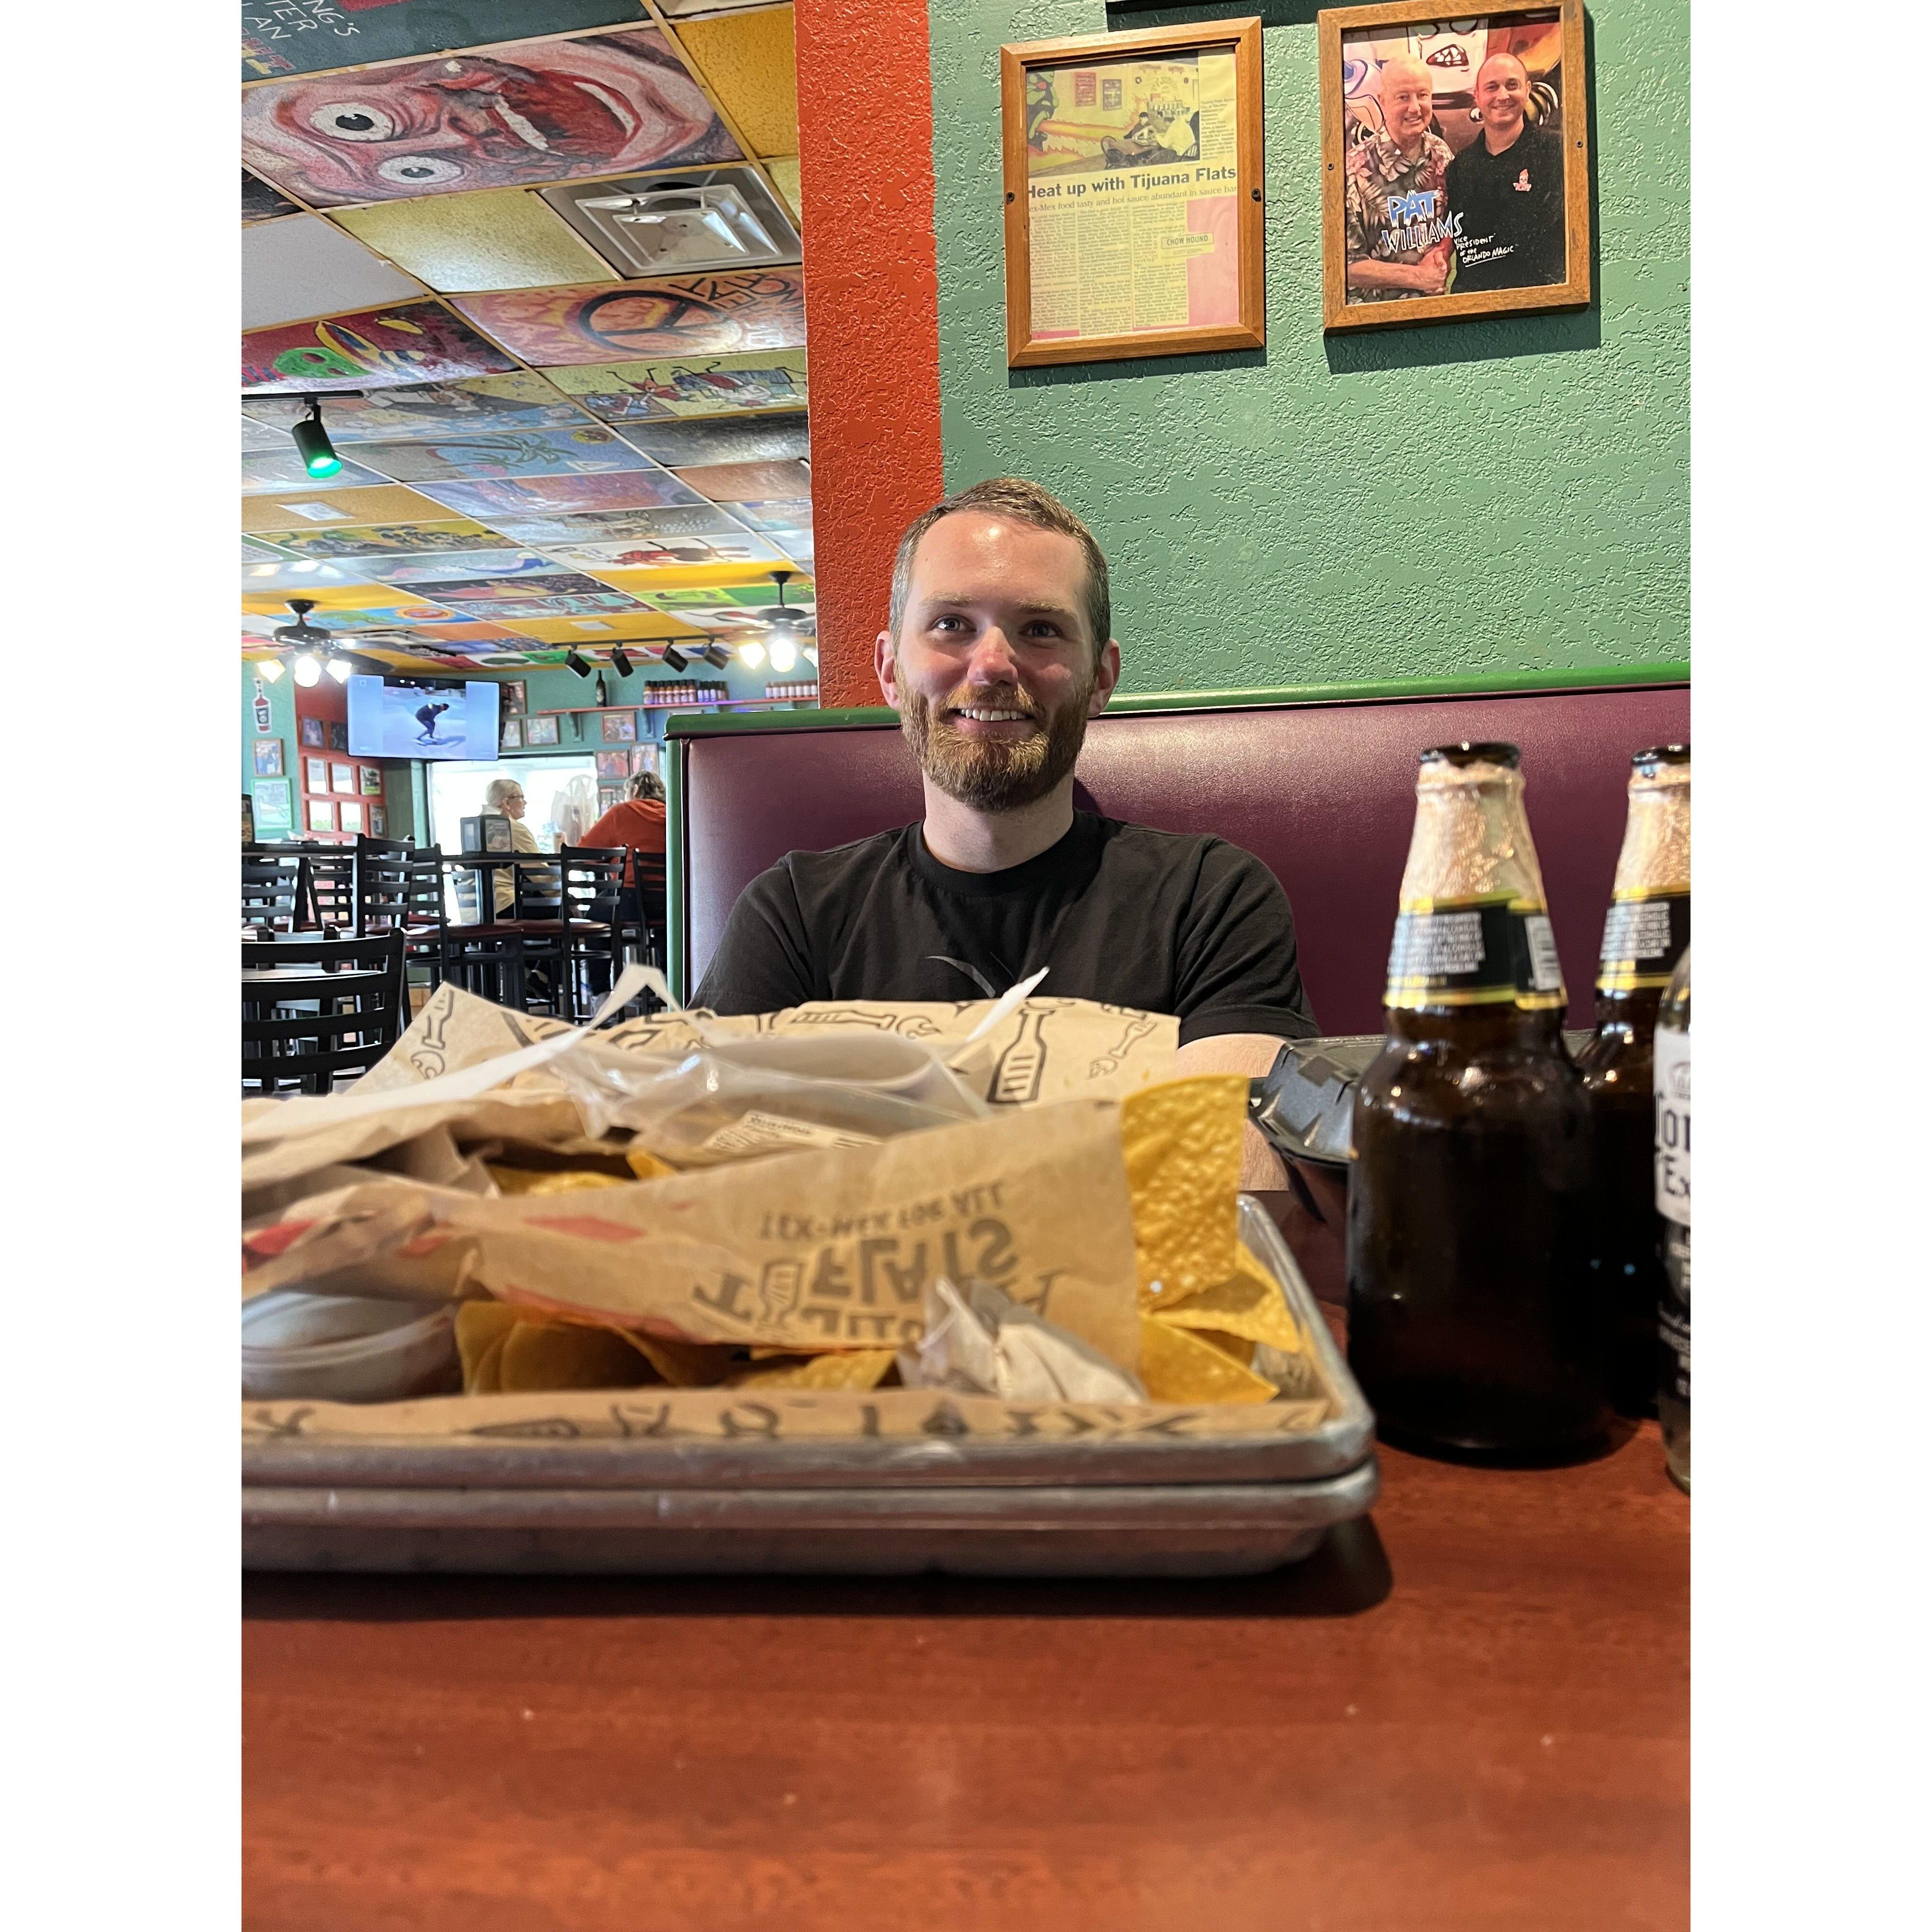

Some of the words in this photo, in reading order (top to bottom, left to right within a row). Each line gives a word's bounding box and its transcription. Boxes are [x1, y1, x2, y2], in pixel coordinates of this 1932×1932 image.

[1028, 183, 1061, 198] Heat
[1067, 184, 1087, 197] up
[1092, 176, 1125, 192] with
[1130, 173, 1190, 190] Tijuana
[1196, 166, 1237, 182] Flats
[1029, 203, 1056, 212] ex-Mex
[1058, 201, 1075, 210] food
[1077, 200, 1094, 209] tasty
[1096, 197, 1110, 206] and
[1151, 191, 1187, 201] abundant
[1189, 189, 1197, 197] in
[1199, 186, 1222, 196] sauce
[1387, 189, 1441, 229] PAT
[1166, 237, 1184, 245] CHOW
[1186, 235, 1208, 244] HOUND
[1381, 211, 1464, 253] WILLIAMS
[1462, 251, 1491, 264] ORLANDO
[1492, 245, 1514, 258] MAGIC
